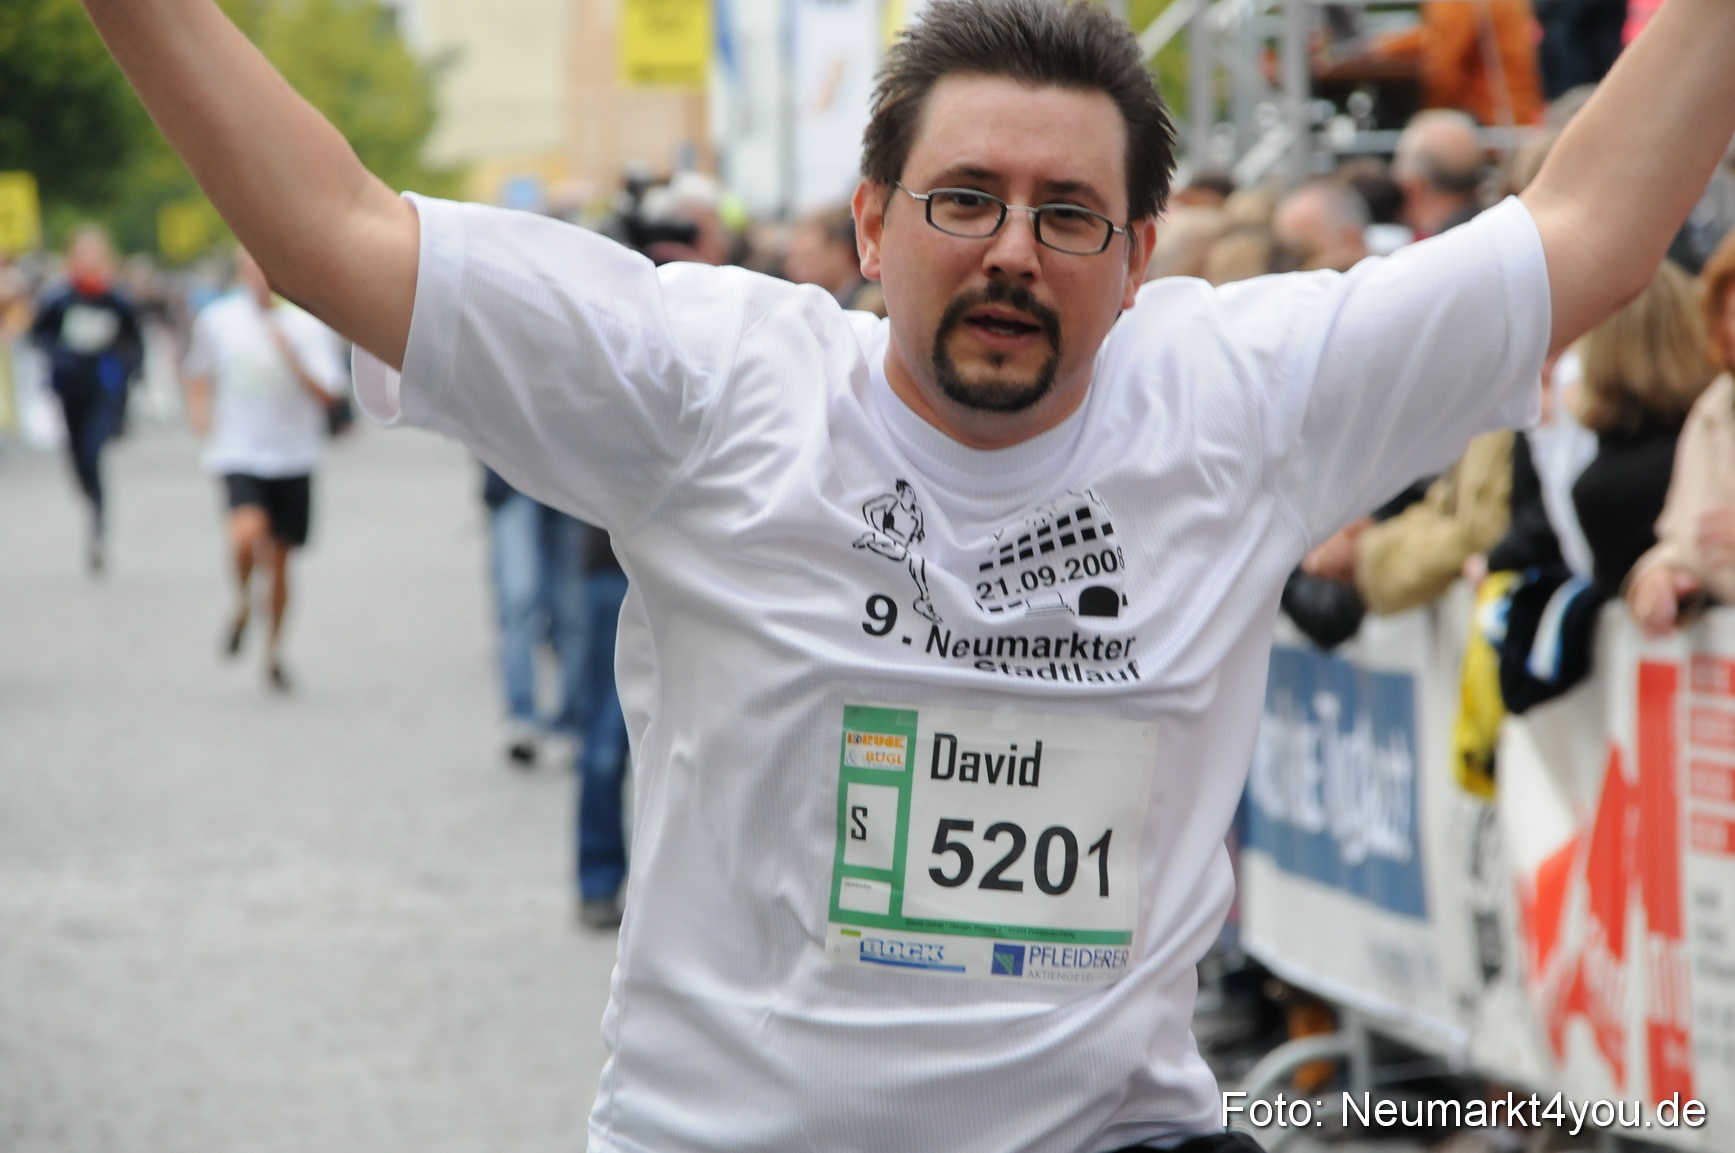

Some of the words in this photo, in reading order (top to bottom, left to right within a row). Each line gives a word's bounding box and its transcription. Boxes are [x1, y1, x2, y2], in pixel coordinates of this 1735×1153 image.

[975, 545, 1126, 601] 21.09.2008
[861, 593, 912, 646] 9.
[925, 623, 1137, 659] Neumarkter
[973, 660, 1141, 683] Stadtlauf
[930, 732, 1043, 787] David
[851, 806, 868, 840] S
[928, 818, 1113, 898] 5201
[1028, 945, 1130, 969] PFLEIDERER
